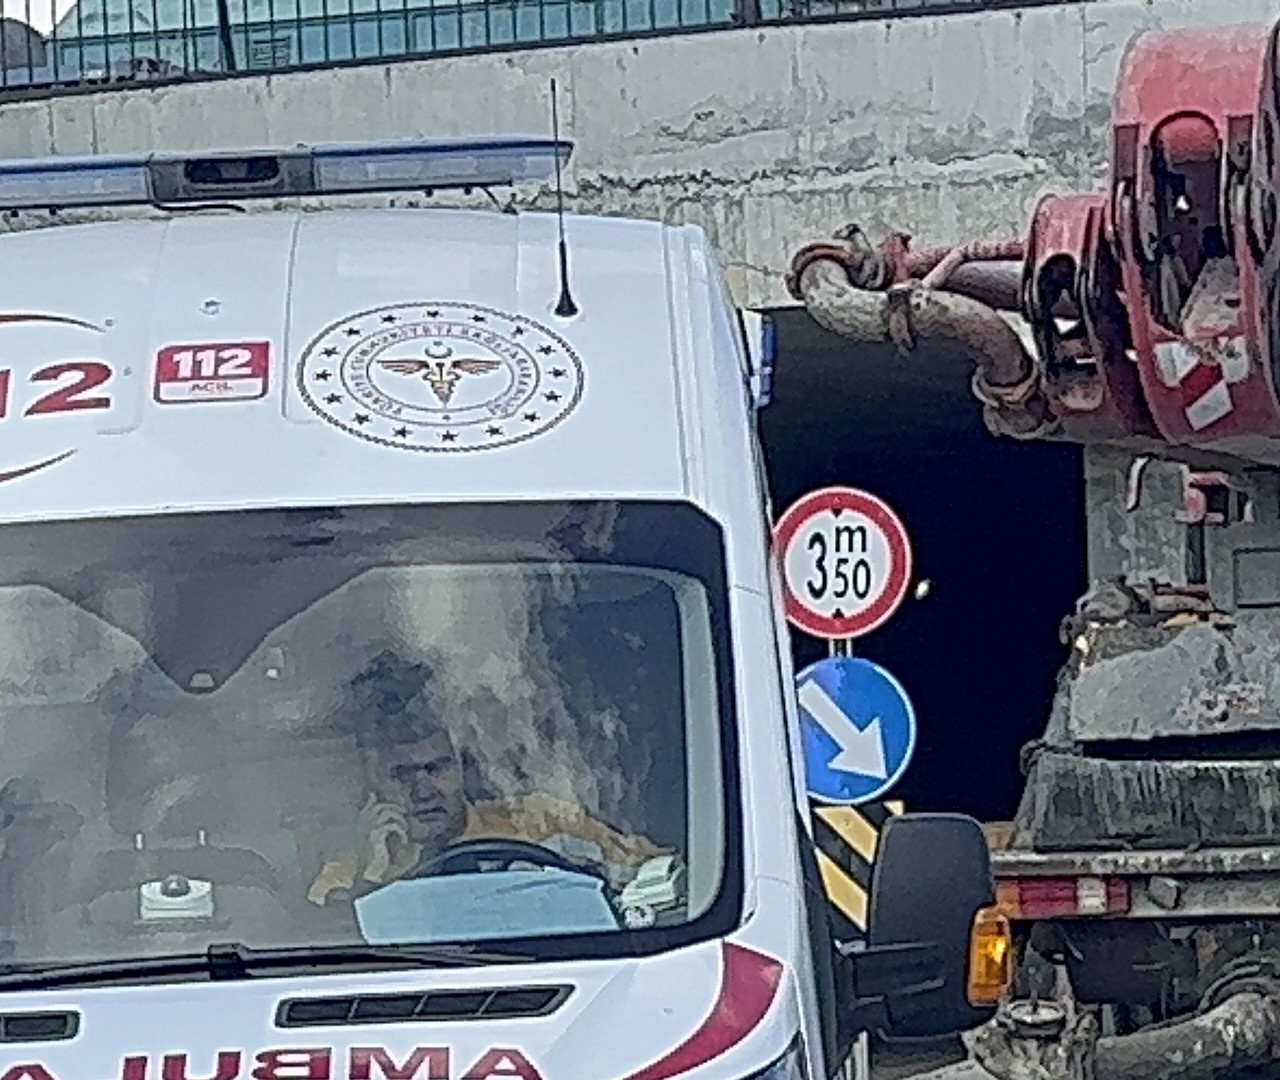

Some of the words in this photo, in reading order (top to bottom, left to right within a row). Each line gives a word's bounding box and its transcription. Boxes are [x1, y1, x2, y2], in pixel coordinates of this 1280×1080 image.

[172, 348, 253, 379] 112
[835, 523, 867, 553] m
[806, 531, 828, 600] 3
[834, 557, 871, 600] 50
